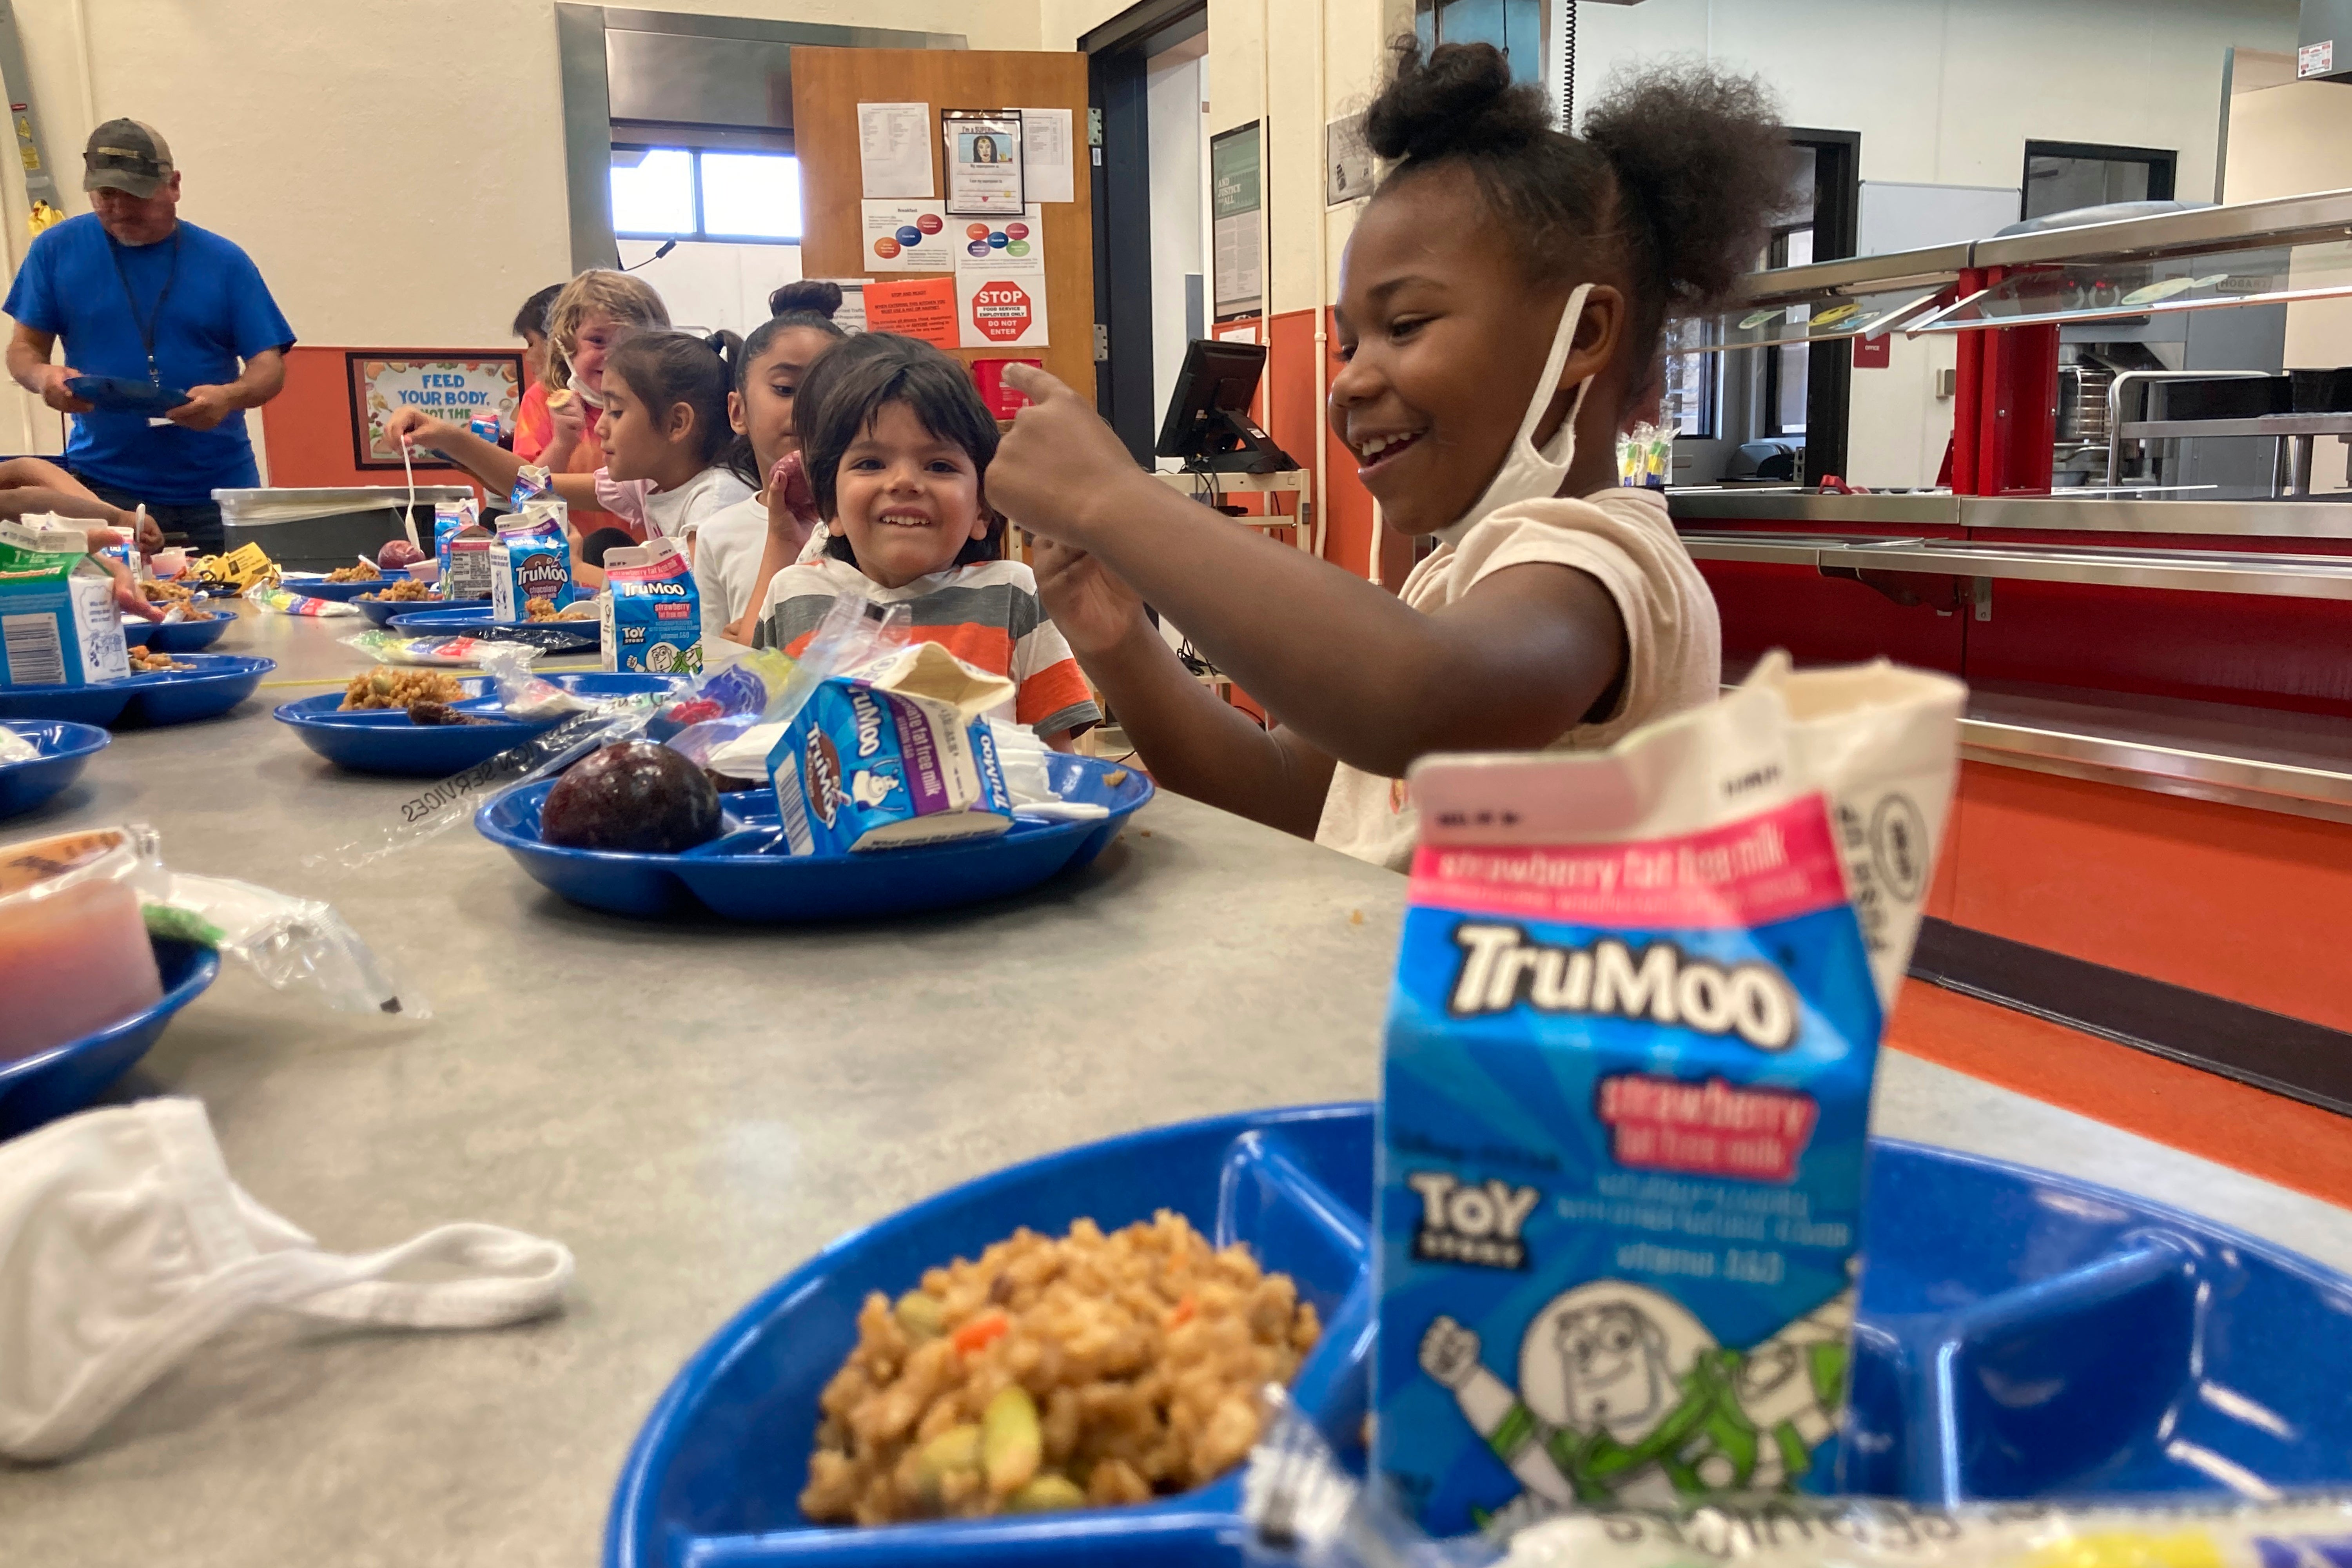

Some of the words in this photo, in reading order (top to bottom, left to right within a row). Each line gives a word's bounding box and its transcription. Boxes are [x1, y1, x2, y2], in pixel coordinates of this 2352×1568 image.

[1218, 178, 1230, 188] AND
[1218, 183, 1241, 197] JUSTICE
[1223, 196, 1234, 206] ALL
[979, 291, 1023, 303] STOP
[422, 374, 465, 389] FEED
[398, 390, 442, 405] YOUR
[445, 391, 490, 406] BODY,
[421, 408, 444, 419] NOT
[448, 408, 471, 419] THE
[506, 538, 540, 547] TruMoo
[515, 565, 568, 586] TruMoo
[529, 585, 557, 594] chocolate
[622, 582, 685, 597] TruMoo
[655, 603, 690, 611] strawberry
[622, 627, 646, 638] TOY
[911, 727, 929, 746] fat
[914, 745, 933, 771] free
[807, 721, 837, 830] TruMoo
[980, 735, 1011, 809] TruMoo
[921, 770, 942, 797] milk
[1436, 851, 1620, 895] strawberry
[1623, 849, 1673, 887] fat
[1679, 846, 1730, 887] free
[1730, 822, 1786, 878] milk
[1452, 924, 1794, 1049] TruMoo
[1600, 1073, 1806, 1138] strawberry
[1408, 1171, 1539, 1240] TOY
